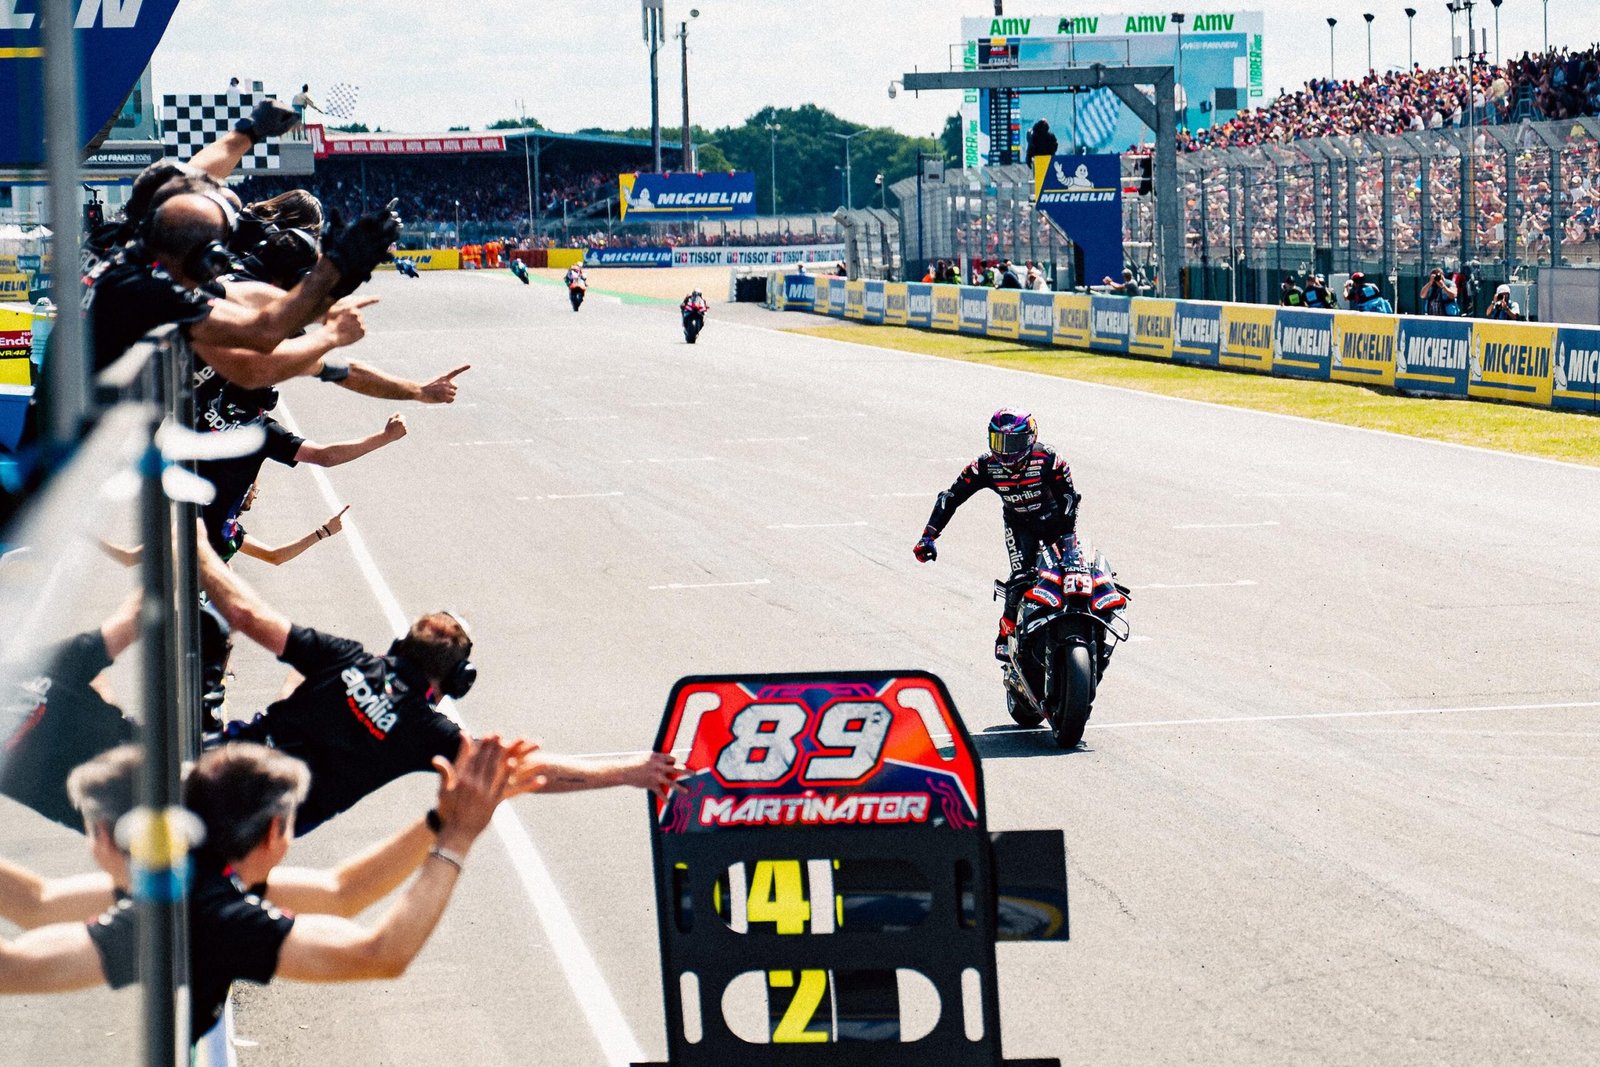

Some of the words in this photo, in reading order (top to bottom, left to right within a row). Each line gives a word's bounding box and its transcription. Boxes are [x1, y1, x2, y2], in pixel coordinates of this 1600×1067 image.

[657, 191, 752, 205] MICHELIN
[1040, 191, 1116, 204] MICHELIN
[601, 252, 672, 262] MICHELIN
[689, 252, 722, 264] TISSOT
[738, 252, 768, 264] TISSOT
[783, 251, 803, 262] TISSOT
[1096, 310, 1129, 334] MICHELIN
[1136, 314, 1172, 338] MICHELIN
[1180, 316, 1219, 344] MICHELIN
[1228, 320, 1272, 349] MICHELIN
[1283, 326, 1330, 357] MICHELIN
[1342, 332, 1394, 362] MICHELIN
[1406, 336, 1469, 370] MICHELIN
[1483, 342, 1551, 378] MICHELIN
[1003, 490, 1041, 503] aprilia
[1005, 527, 1024, 571] aprilia
[1063, 574, 1092, 594] 89
[341, 666, 397, 733] aprilia
[713, 701, 895, 784] 89
[701, 792, 928, 825] MARTINATOR
